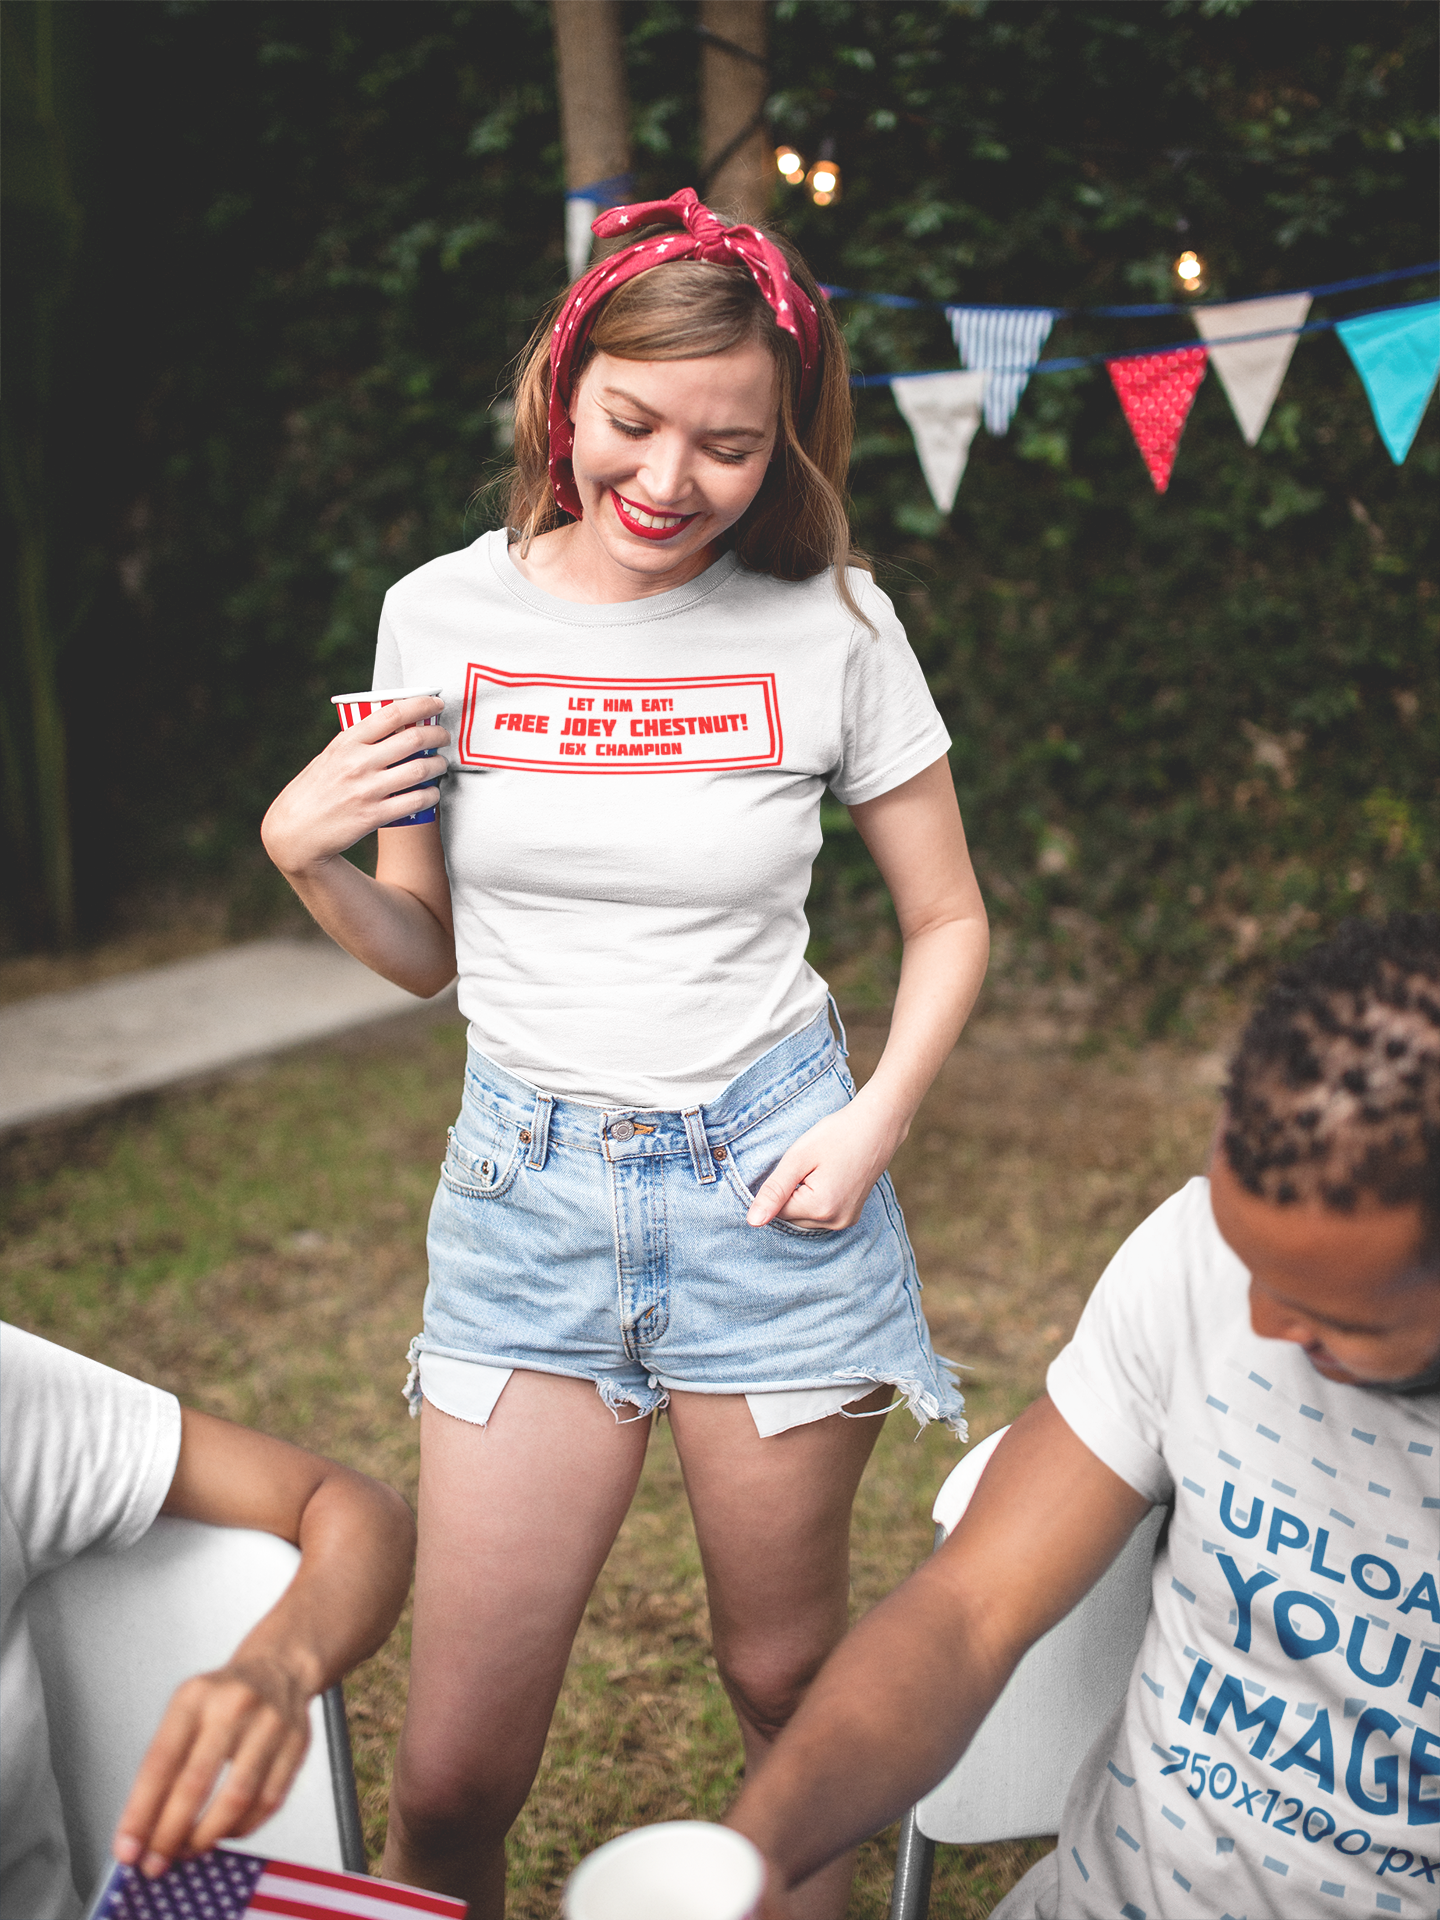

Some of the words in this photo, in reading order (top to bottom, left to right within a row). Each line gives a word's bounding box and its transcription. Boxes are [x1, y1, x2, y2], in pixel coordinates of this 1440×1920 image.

[568, 697, 595, 711] LET
[604, 698, 633, 712] HIM
[641, 698, 674, 712] EAT!
[494, 713, 550, 734] FREE
[560, 718, 617, 737] JOEY
[630, 714, 748, 737] CHESTNUT!
[559, 743, 586, 755] 16X
[595, 742, 682, 756] CHAMPION
[1218, 1480, 1440, 1625] UPLOA
[1177, 1657, 1440, 1827] IMAGE
[1375, 1846, 1440, 1885] px
